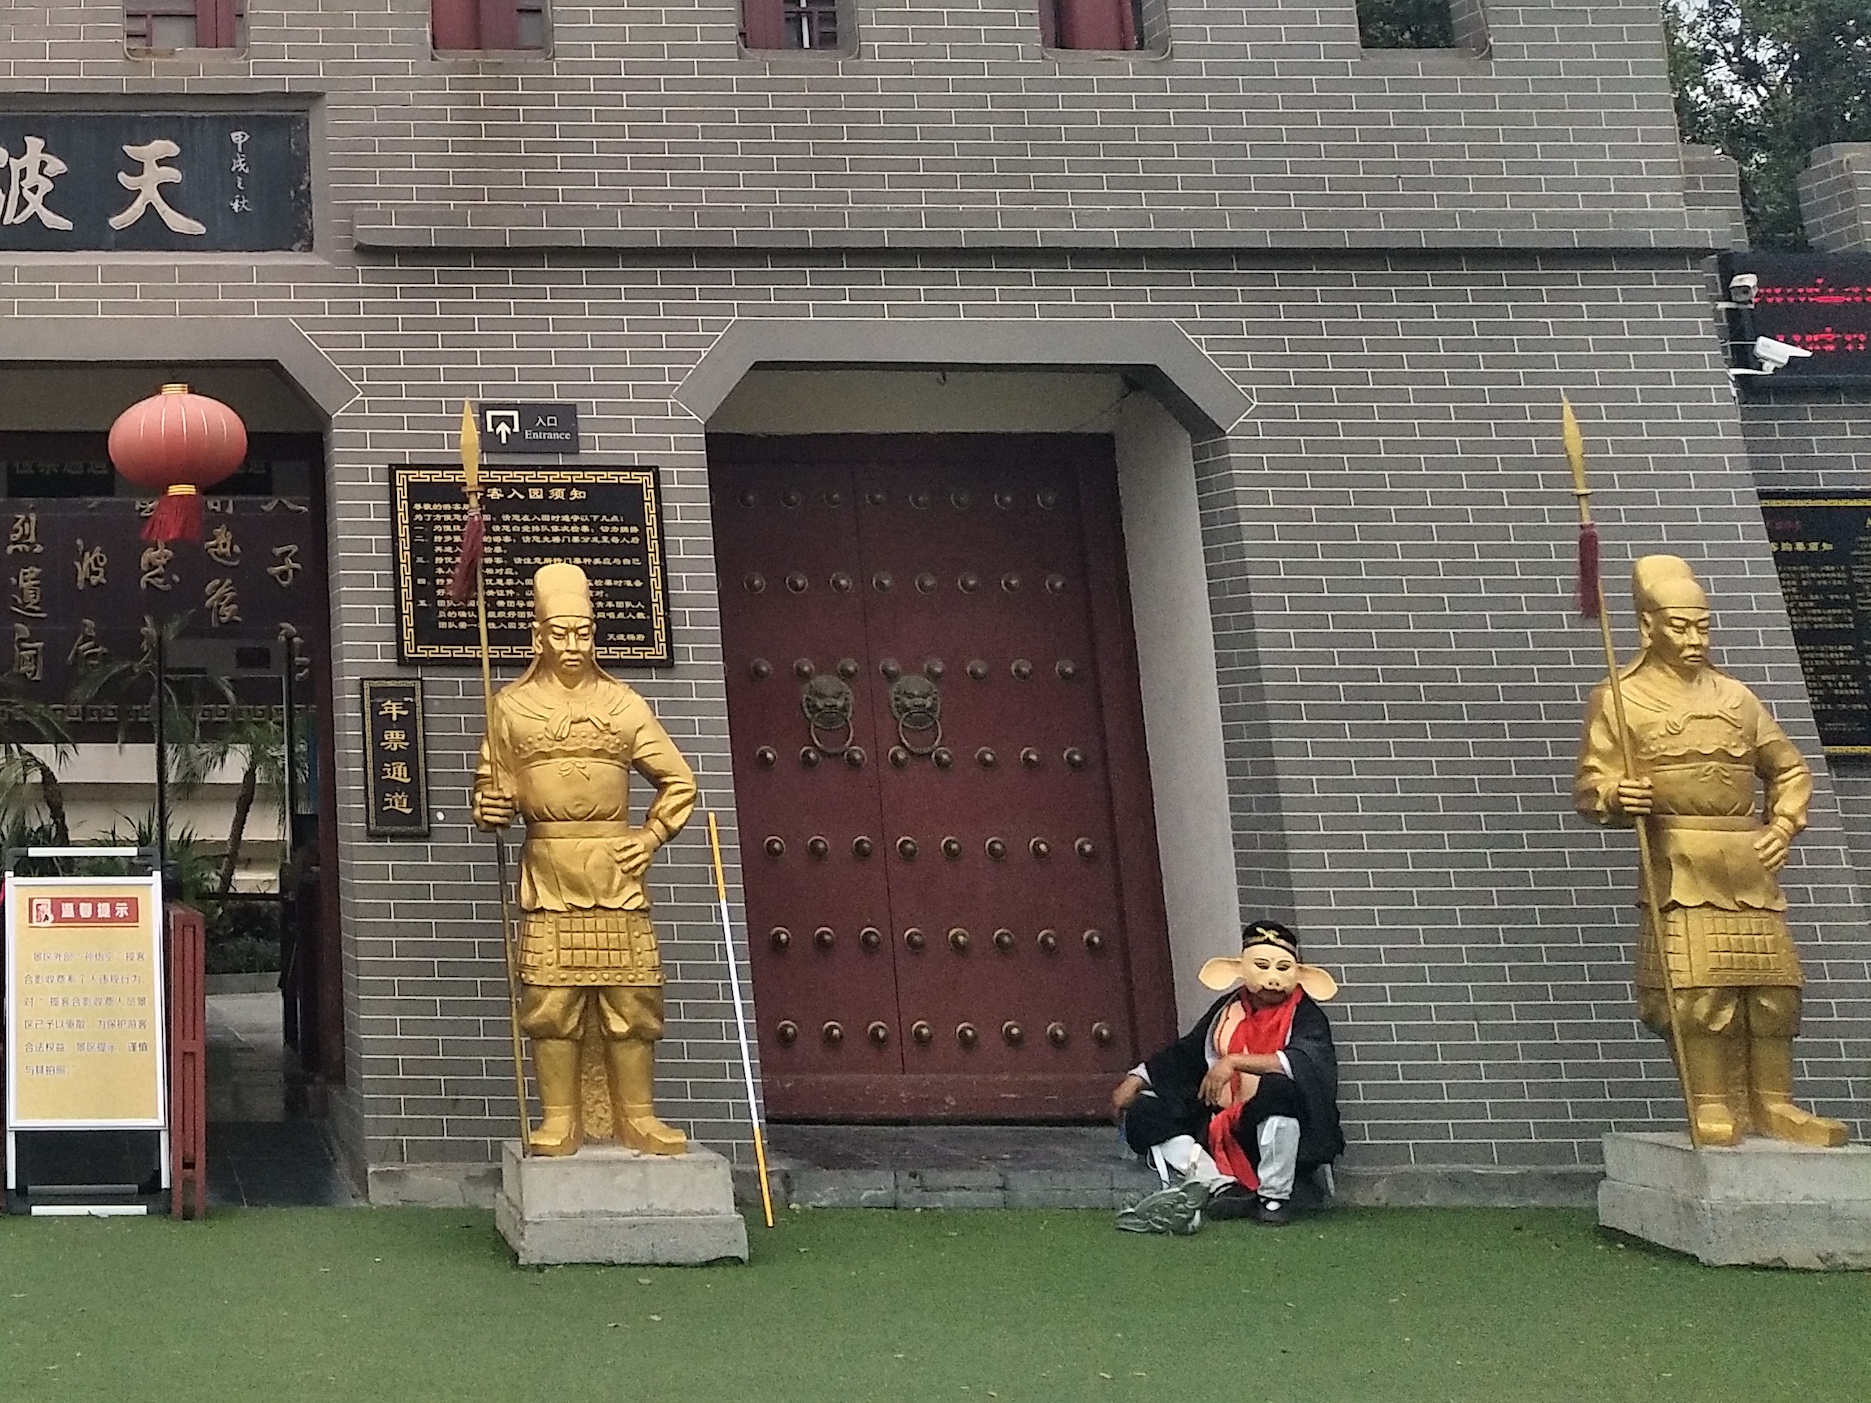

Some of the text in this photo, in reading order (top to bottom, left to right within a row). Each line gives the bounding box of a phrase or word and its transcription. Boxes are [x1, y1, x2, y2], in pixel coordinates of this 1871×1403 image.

[534, 415, 558, 427] 入口
[524, 429, 571, 441] Entrance
[477, 487, 587, 501] 客入园须知
[377, 699, 414, 815] 年票通道
[60, 901, 129, 919] 温馨提示
